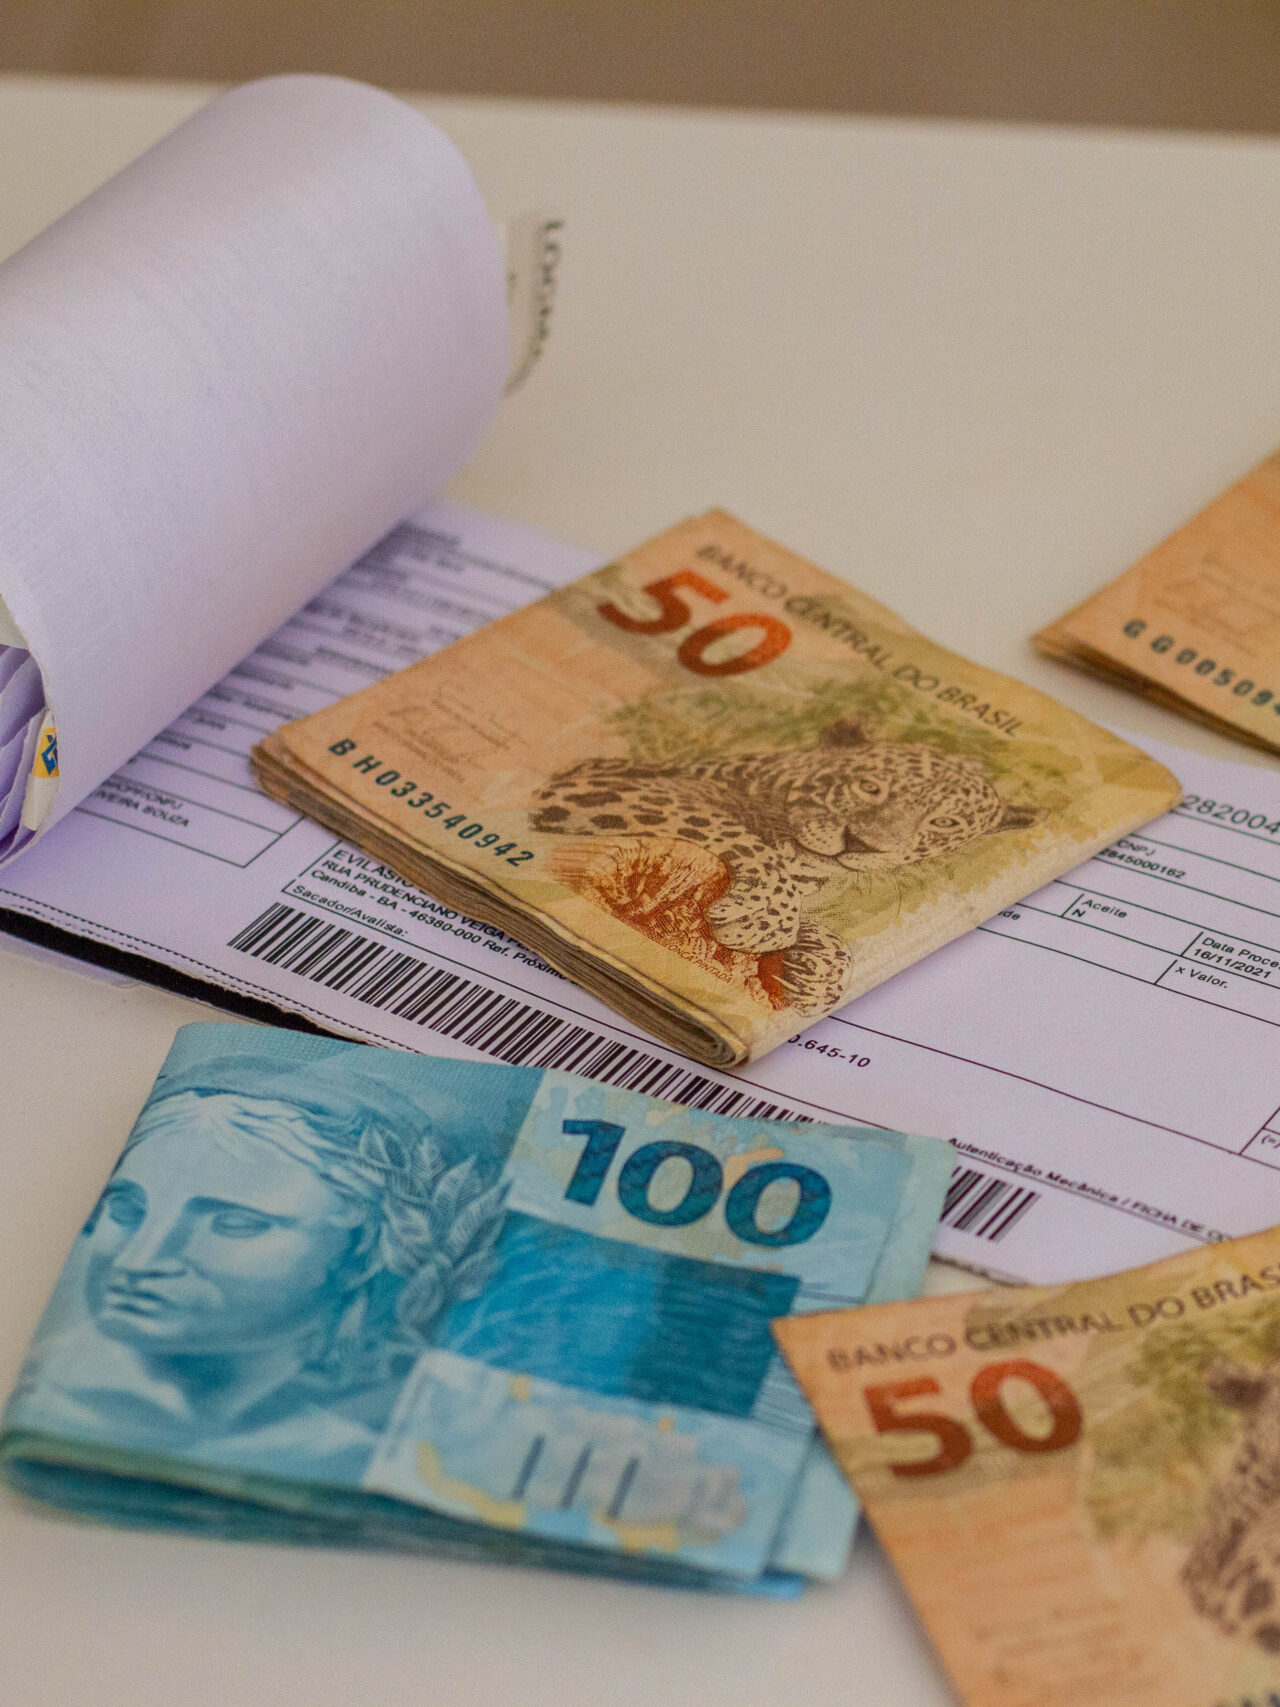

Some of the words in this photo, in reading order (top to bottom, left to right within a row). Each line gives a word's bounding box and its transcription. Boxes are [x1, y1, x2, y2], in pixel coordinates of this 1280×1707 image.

[597, 569, 793, 677] 50
[695, 543, 788, 600] BANCO
[783, 595, 893, 672] CENTRAL
[892, 660, 940, 692] DO
[936, 684, 1025, 738] BRASIL
[311, 869, 367, 897] Candiba
[377, 896, 399, 910] BA
[408, 910, 482, 944] 46380-000
[482, 939, 509, 957] Ref.
[322, 859, 352, 878] RUA
[354, 872, 457, 920] PRUDENCIANO
[460, 915, 505, 942] VEIGA
[1071, 908, 1086, 919] N
[1081, 897, 1128, 919] Aceite
[693, 956, 733, 983] PINTADA
[1193, 947, 1272, 980] 16/11/2021
[1201, 936, 1235, 955] Data
[562, 1119, 833, 1248] 100
[948, 1136, 1042, 1177] Autenticação
[1046, 1170, 1118, 1203] Mecânica
[827, 1334, 957, 1372] BANCO
[964, 1311, 1126, 1352] CENTRAL
[1127, 1297, 1186, 1327] DO
[863, 1357, 1084, 1479] 50
